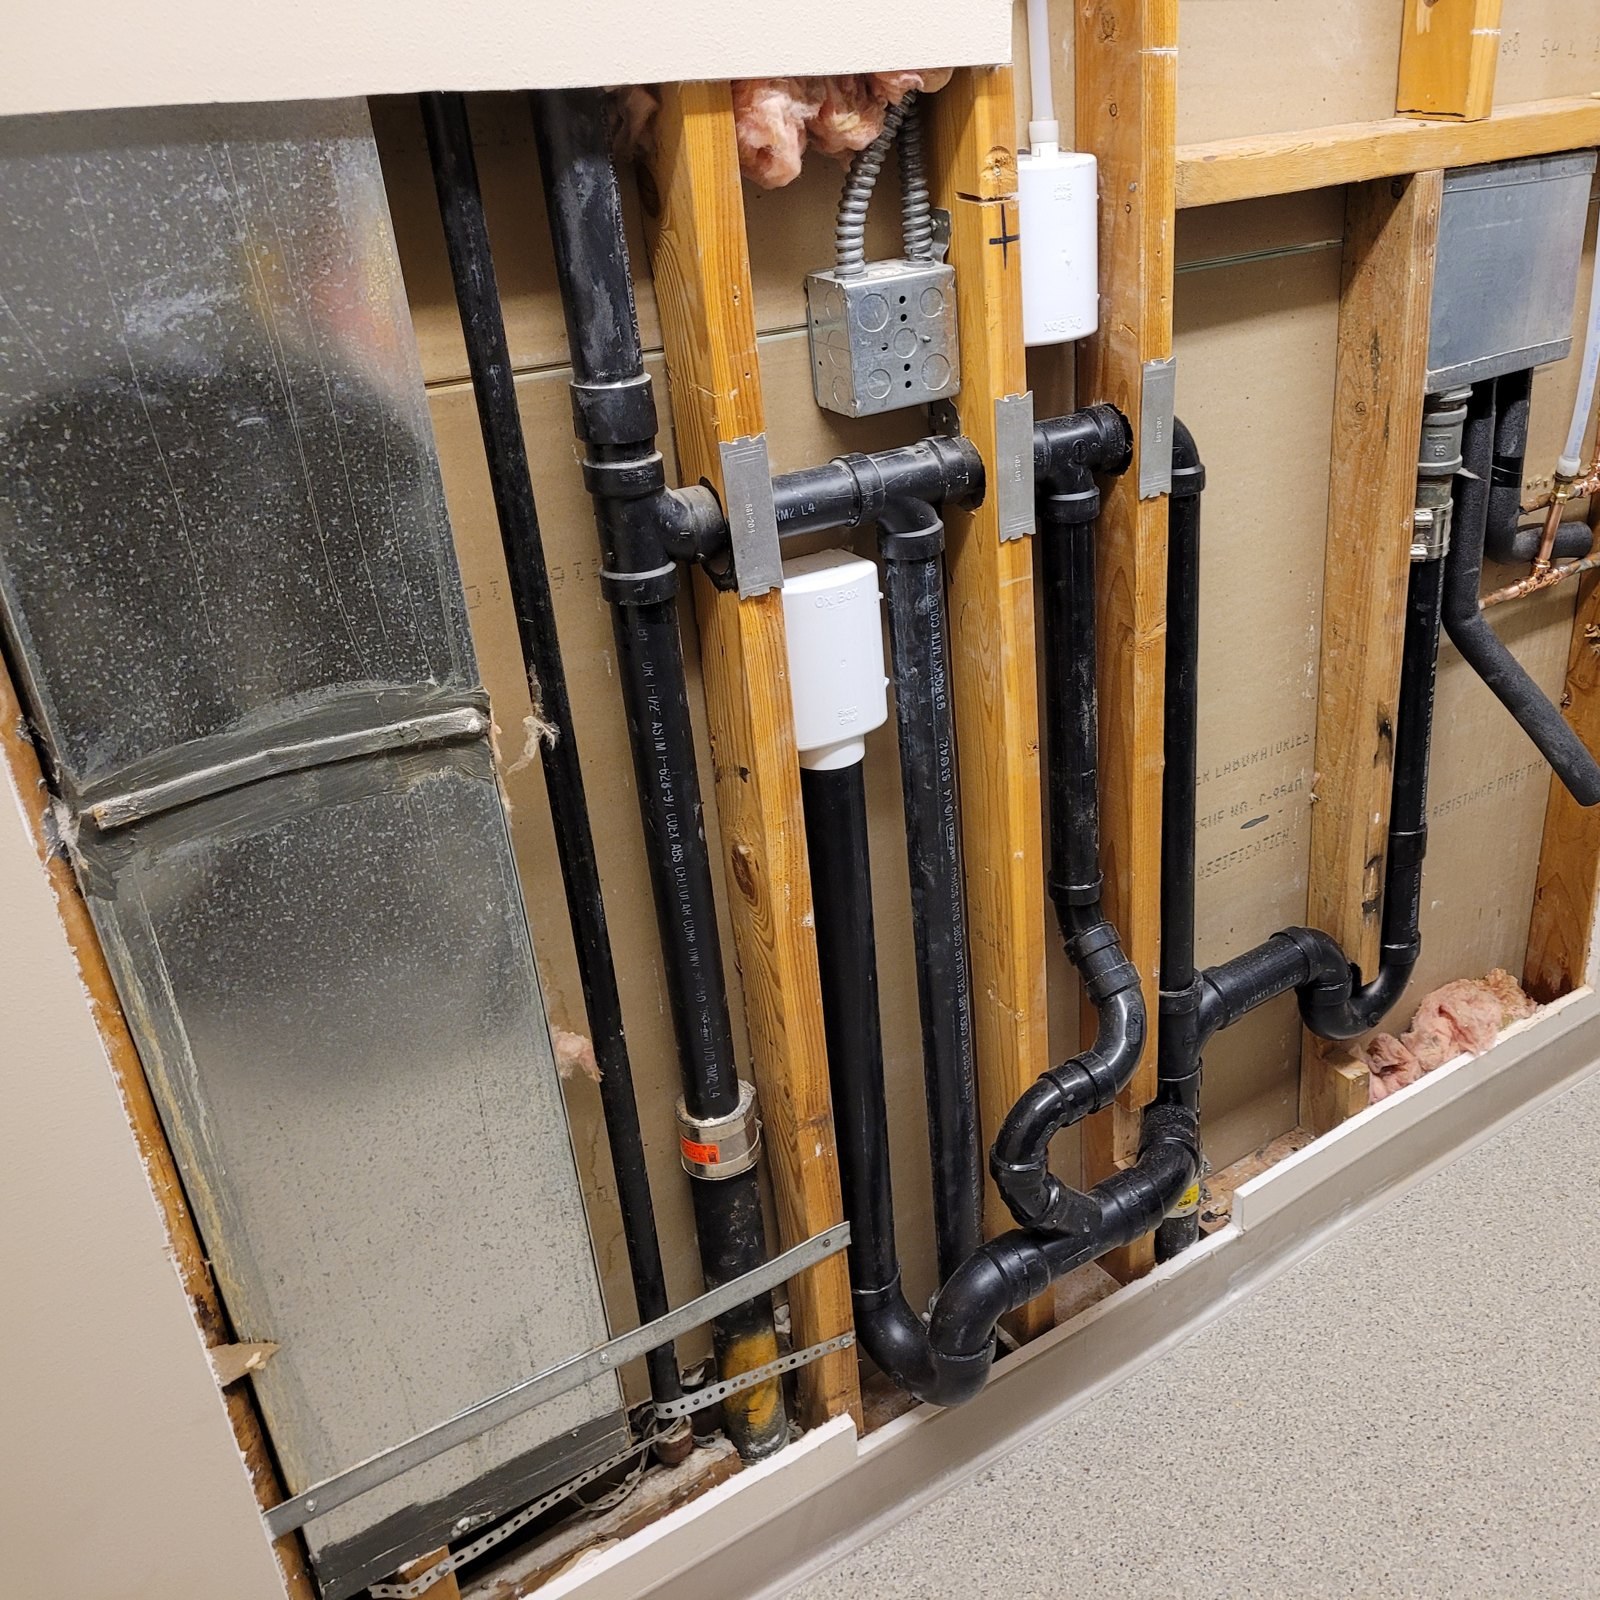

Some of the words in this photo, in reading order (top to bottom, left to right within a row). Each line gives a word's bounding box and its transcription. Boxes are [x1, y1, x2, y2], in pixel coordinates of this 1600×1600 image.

[799, 501, 816, 516] L4
[924, 559, 937, 576] OR
[926, 592, 940, 628] COLBY
[931, 658, 945, 693] ROCKY
[650, 720, 667, 752] ASTM
[668, 841, 684, 863] ABS
[952, 922, 963, 946] CORE
[954, 948, 966, 992] CELLULAR
